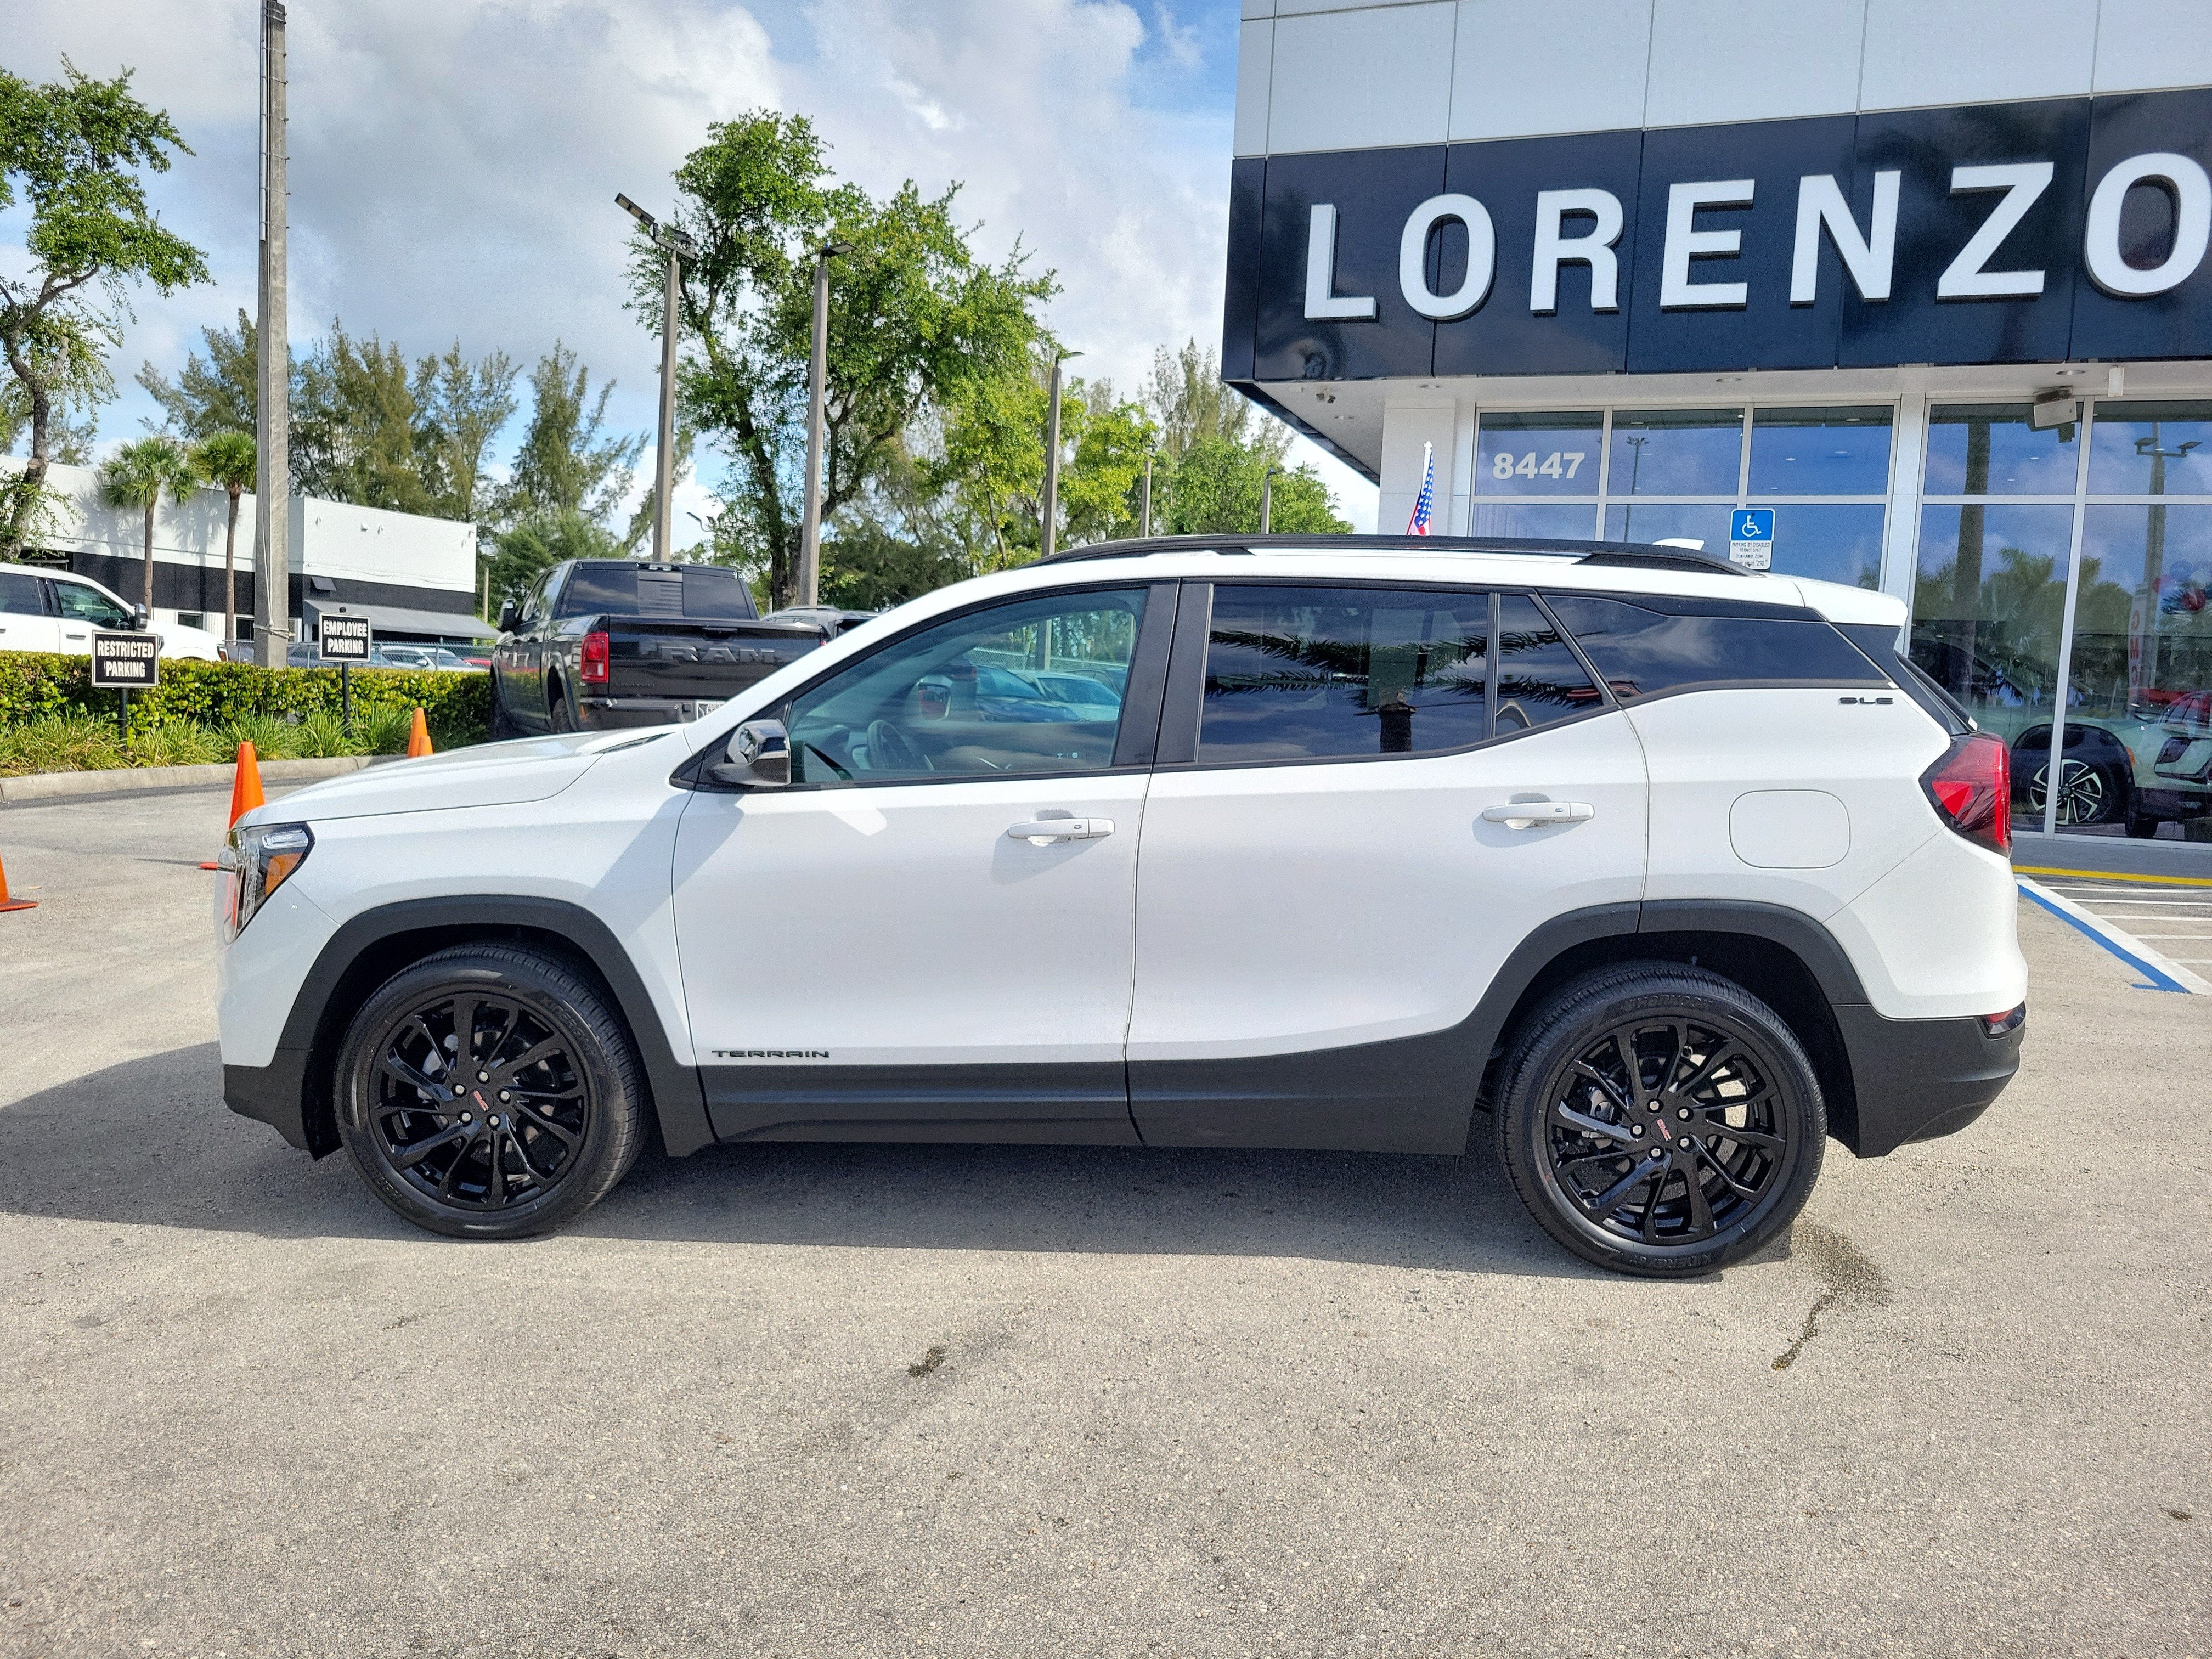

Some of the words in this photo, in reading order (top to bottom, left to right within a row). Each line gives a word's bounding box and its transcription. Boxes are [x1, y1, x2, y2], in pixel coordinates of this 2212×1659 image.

[1304, 153, 2211, 321] LORENZO
[1493, 452, 1585, 480] 8447
[323, 620, 368, 637] EMPLOYEE
[97, 640, 154, 658] RESTRICTED
[327, 637, 364, 654] PARKING
[659, 646, 776, 664] RAM
[105, 661, 146, 678] PARKING
[1839, 696, 1894, 704] SLE
[712, 1050, 830, 1058] TERRAIN
